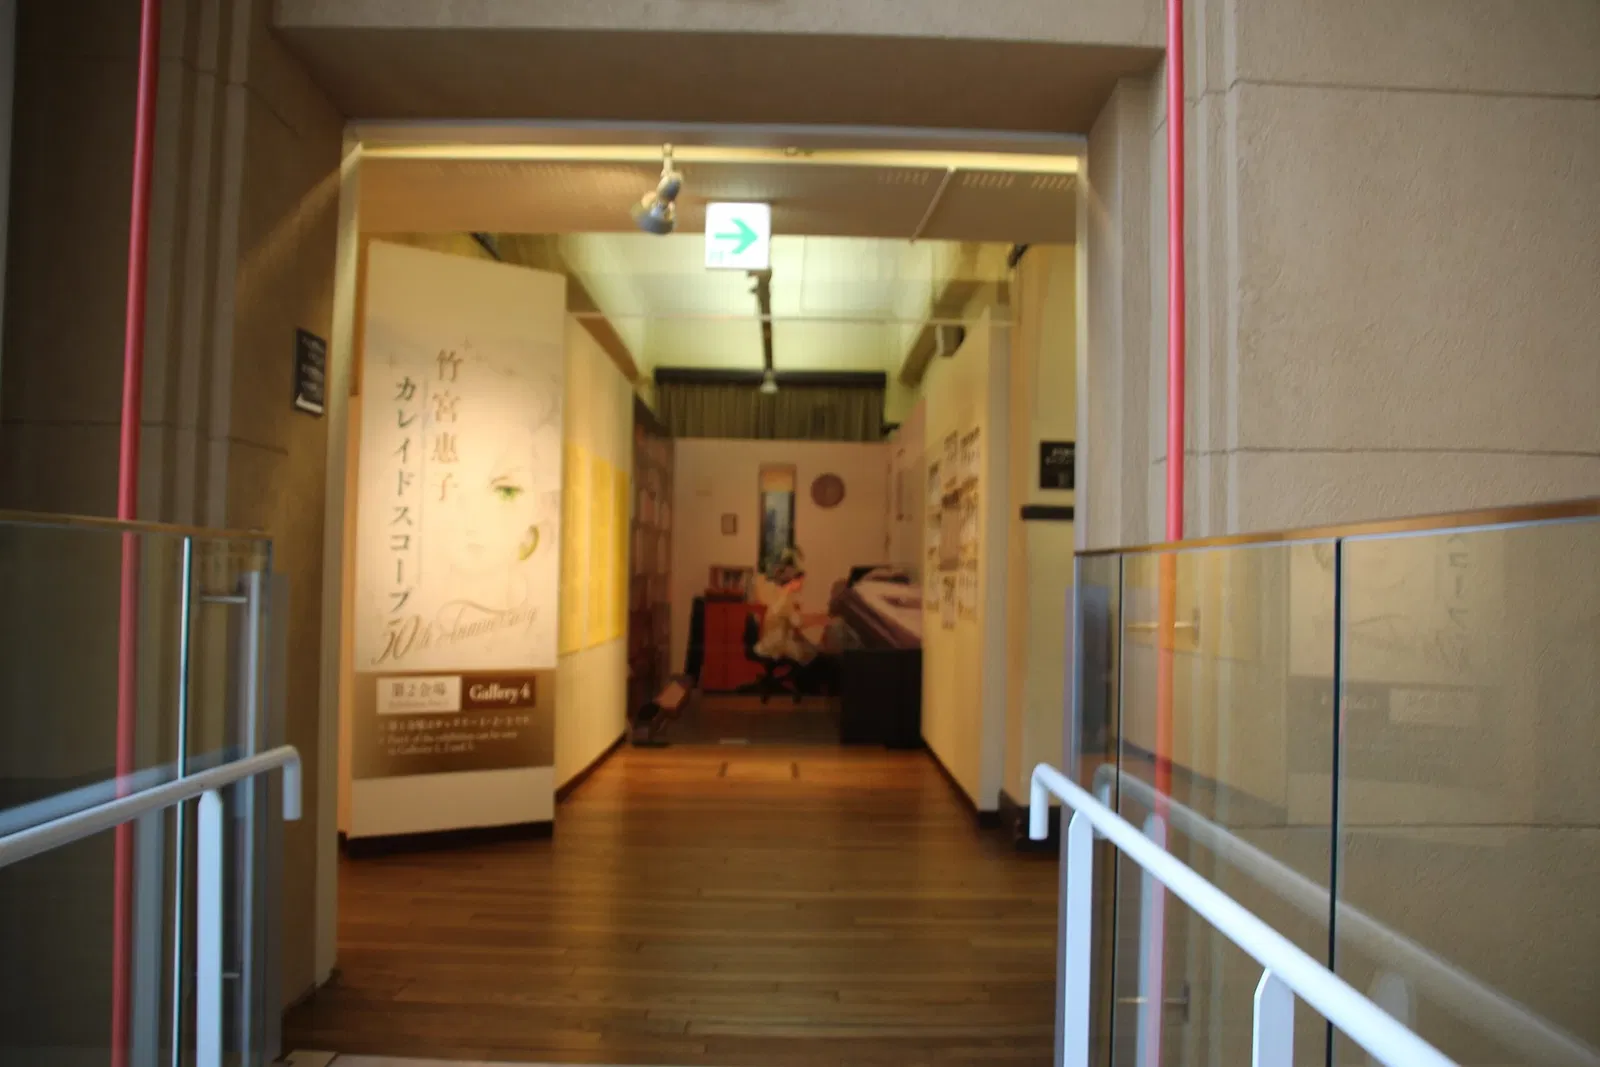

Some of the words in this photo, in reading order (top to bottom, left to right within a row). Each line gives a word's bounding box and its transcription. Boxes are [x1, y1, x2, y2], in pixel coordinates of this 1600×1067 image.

[388, 376, 419, 614] カレイドスコープ
[469, 683, 518, 704] Gallery
